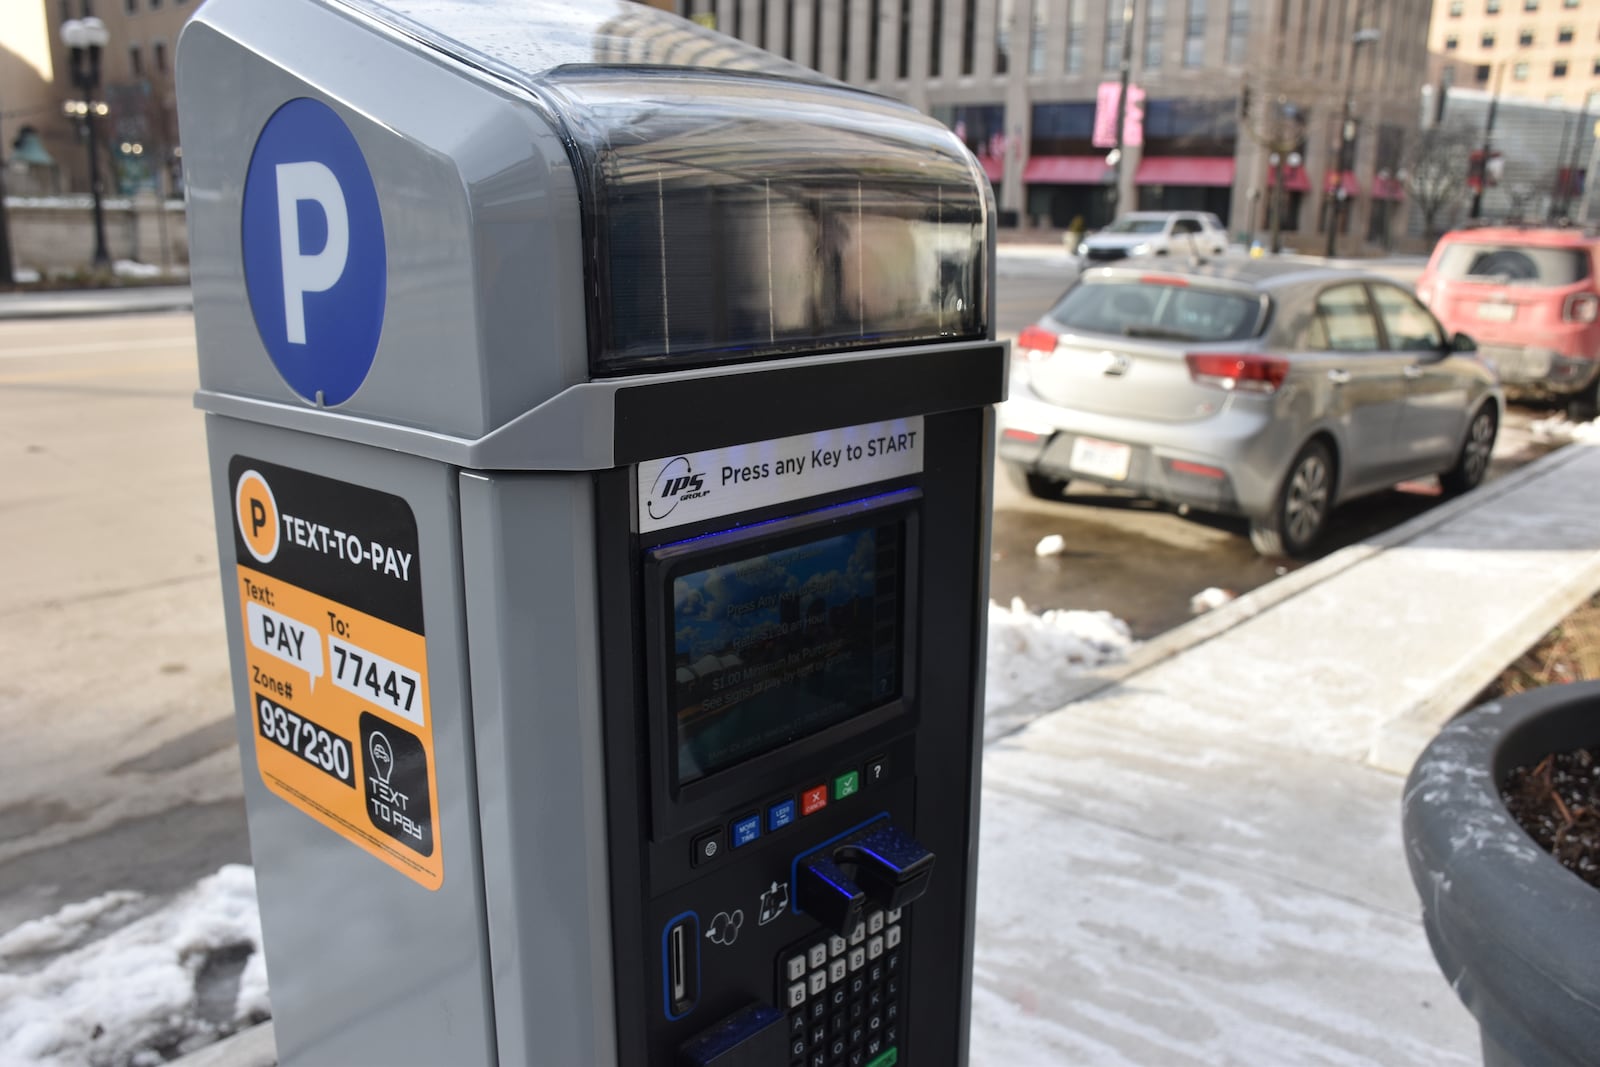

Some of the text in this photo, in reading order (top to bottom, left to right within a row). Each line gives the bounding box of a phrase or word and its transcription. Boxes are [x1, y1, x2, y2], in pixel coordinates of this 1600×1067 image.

[275, 161, 350, 345] P
[722, 431, 917, 487] Press any Key to START
[661, 473, 706, 498] IPS
[680, 490, 710, 501] GROUP
[250, 498, 266, 538] P
[282, 514, 412, 582] TEXT-TO-PAY
[244, 578, 275, 606] Text:
[727, 600, 756, 617] Press
[262, 614, 304, 660] PAY
[328, 612, 350, 638] To:
[252, 665, 293, 699] Zone#
[333, 645, 416, 711] 77447
[261, 700, 350, 780] 937230
[369, 776, 408, 811] TEXT
[371, 798, 391, 822] TO
[739, 820, 756, 833] MORE
[741, 832, 755, 843] TIME
[816, 951, 823, 962] 2
[836, 940, 843, 950] 3
[855, 928, 862, 938] 4
[874, 918, 881, 929] 5
[794, 1018, 803, 1029] A
[816, 1004, 823, 1016] B
[854, 980, 862, 991] D
[873, 968, 880, 979] E
[891, 957, 897, 968] F
[796, 991, 802, 1001] 6
[816, 978, 823, 989] 7
[836, 966, 843, 977] 8
[855, 954, 862, 965] 9
[794, 1042, 803, 1054] G
[815, 1029, 823, 1042] H
[815, 1054, 823, 1067] N
[834, 1042, 843, 1054] O
[853, 1030, 861, 1042] P
[871, 1017, 880, 1029] Q
[852, 1053, 860, 1064] V
[869, 1040, 880, 1053] W
